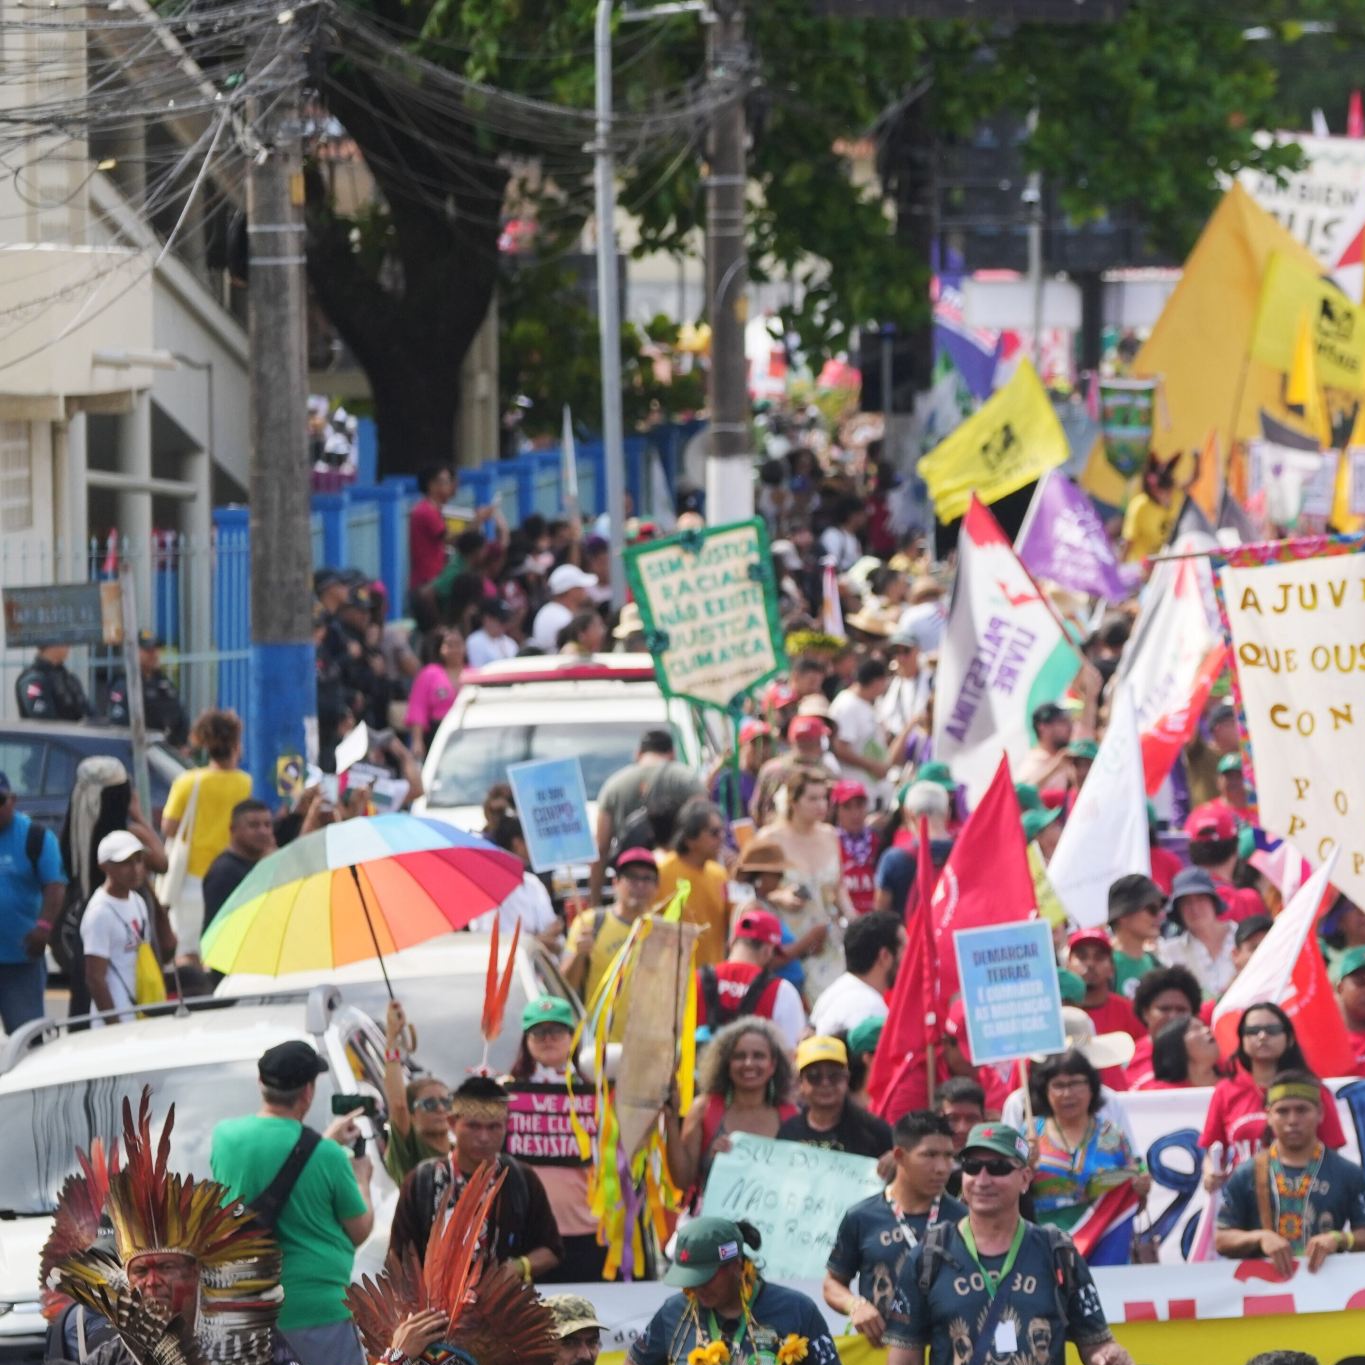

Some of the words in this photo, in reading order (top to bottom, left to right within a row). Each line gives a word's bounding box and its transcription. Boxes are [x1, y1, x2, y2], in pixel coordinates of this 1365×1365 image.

[1239, 586, 1263, 615] A
[1238, 642, 1299, 675] QUE
[987, 963, 1032, 983] TERRAS
[531, 1093, 558, 1113] WE
[562, 1094, 593, 1114] ARE
[511, 1112, 541, 1134] THE
[511, 1132, 581, 1158] RESISTA
[1010, 1273, 1037, 1295] 30
